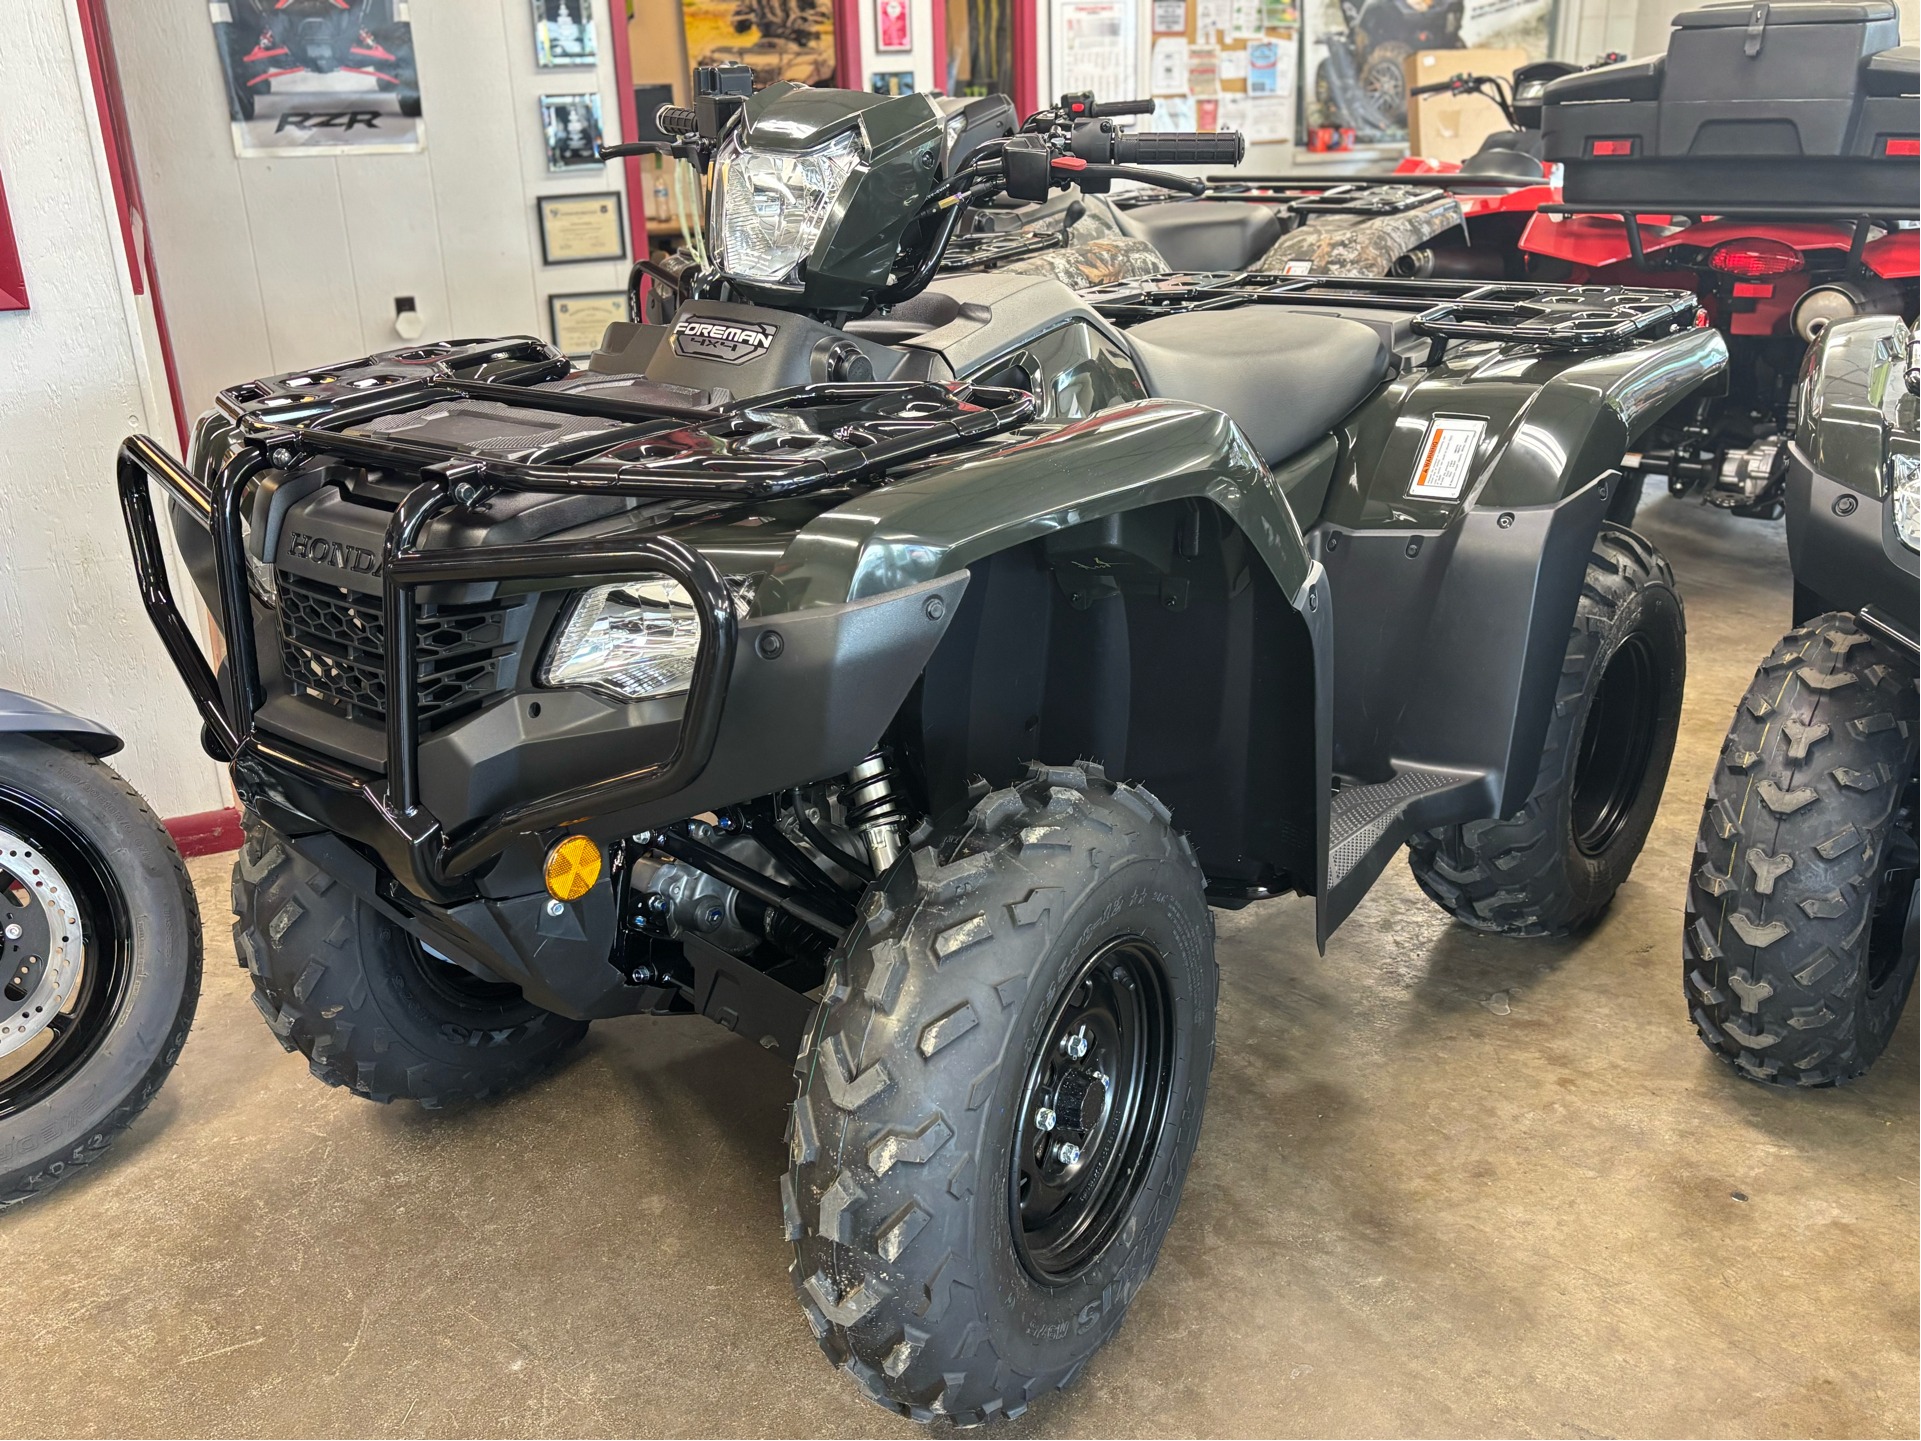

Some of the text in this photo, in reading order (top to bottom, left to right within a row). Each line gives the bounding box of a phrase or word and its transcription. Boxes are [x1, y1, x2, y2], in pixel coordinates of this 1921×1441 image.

[274, 110, 383, 134] RZR
[673, 322, 774, 348] FOREMAN
[1423, 441, 1439, 469] WARNING
